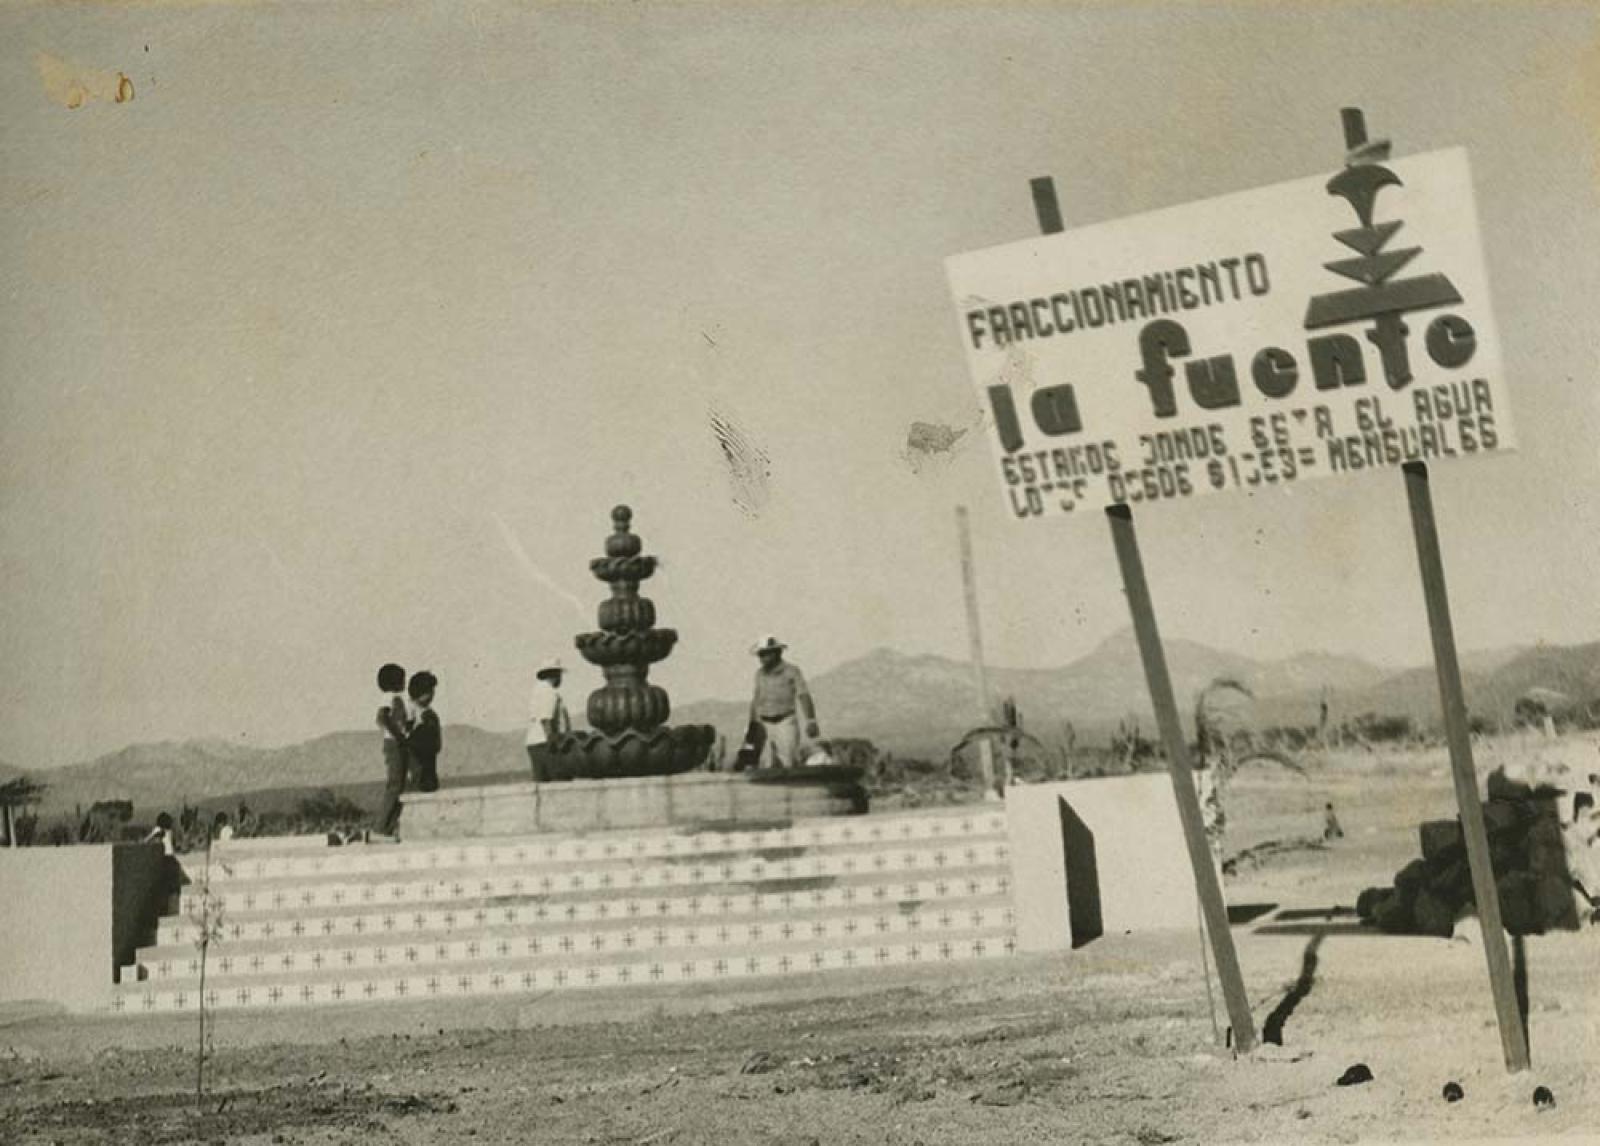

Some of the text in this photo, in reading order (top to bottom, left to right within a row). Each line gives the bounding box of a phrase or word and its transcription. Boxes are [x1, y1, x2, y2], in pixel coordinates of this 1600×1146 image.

[988, 314, 1477, 454] la fuente
[1355, 396, 1393, 431] EL
[1413, 378, 1493, 422] AGUA
